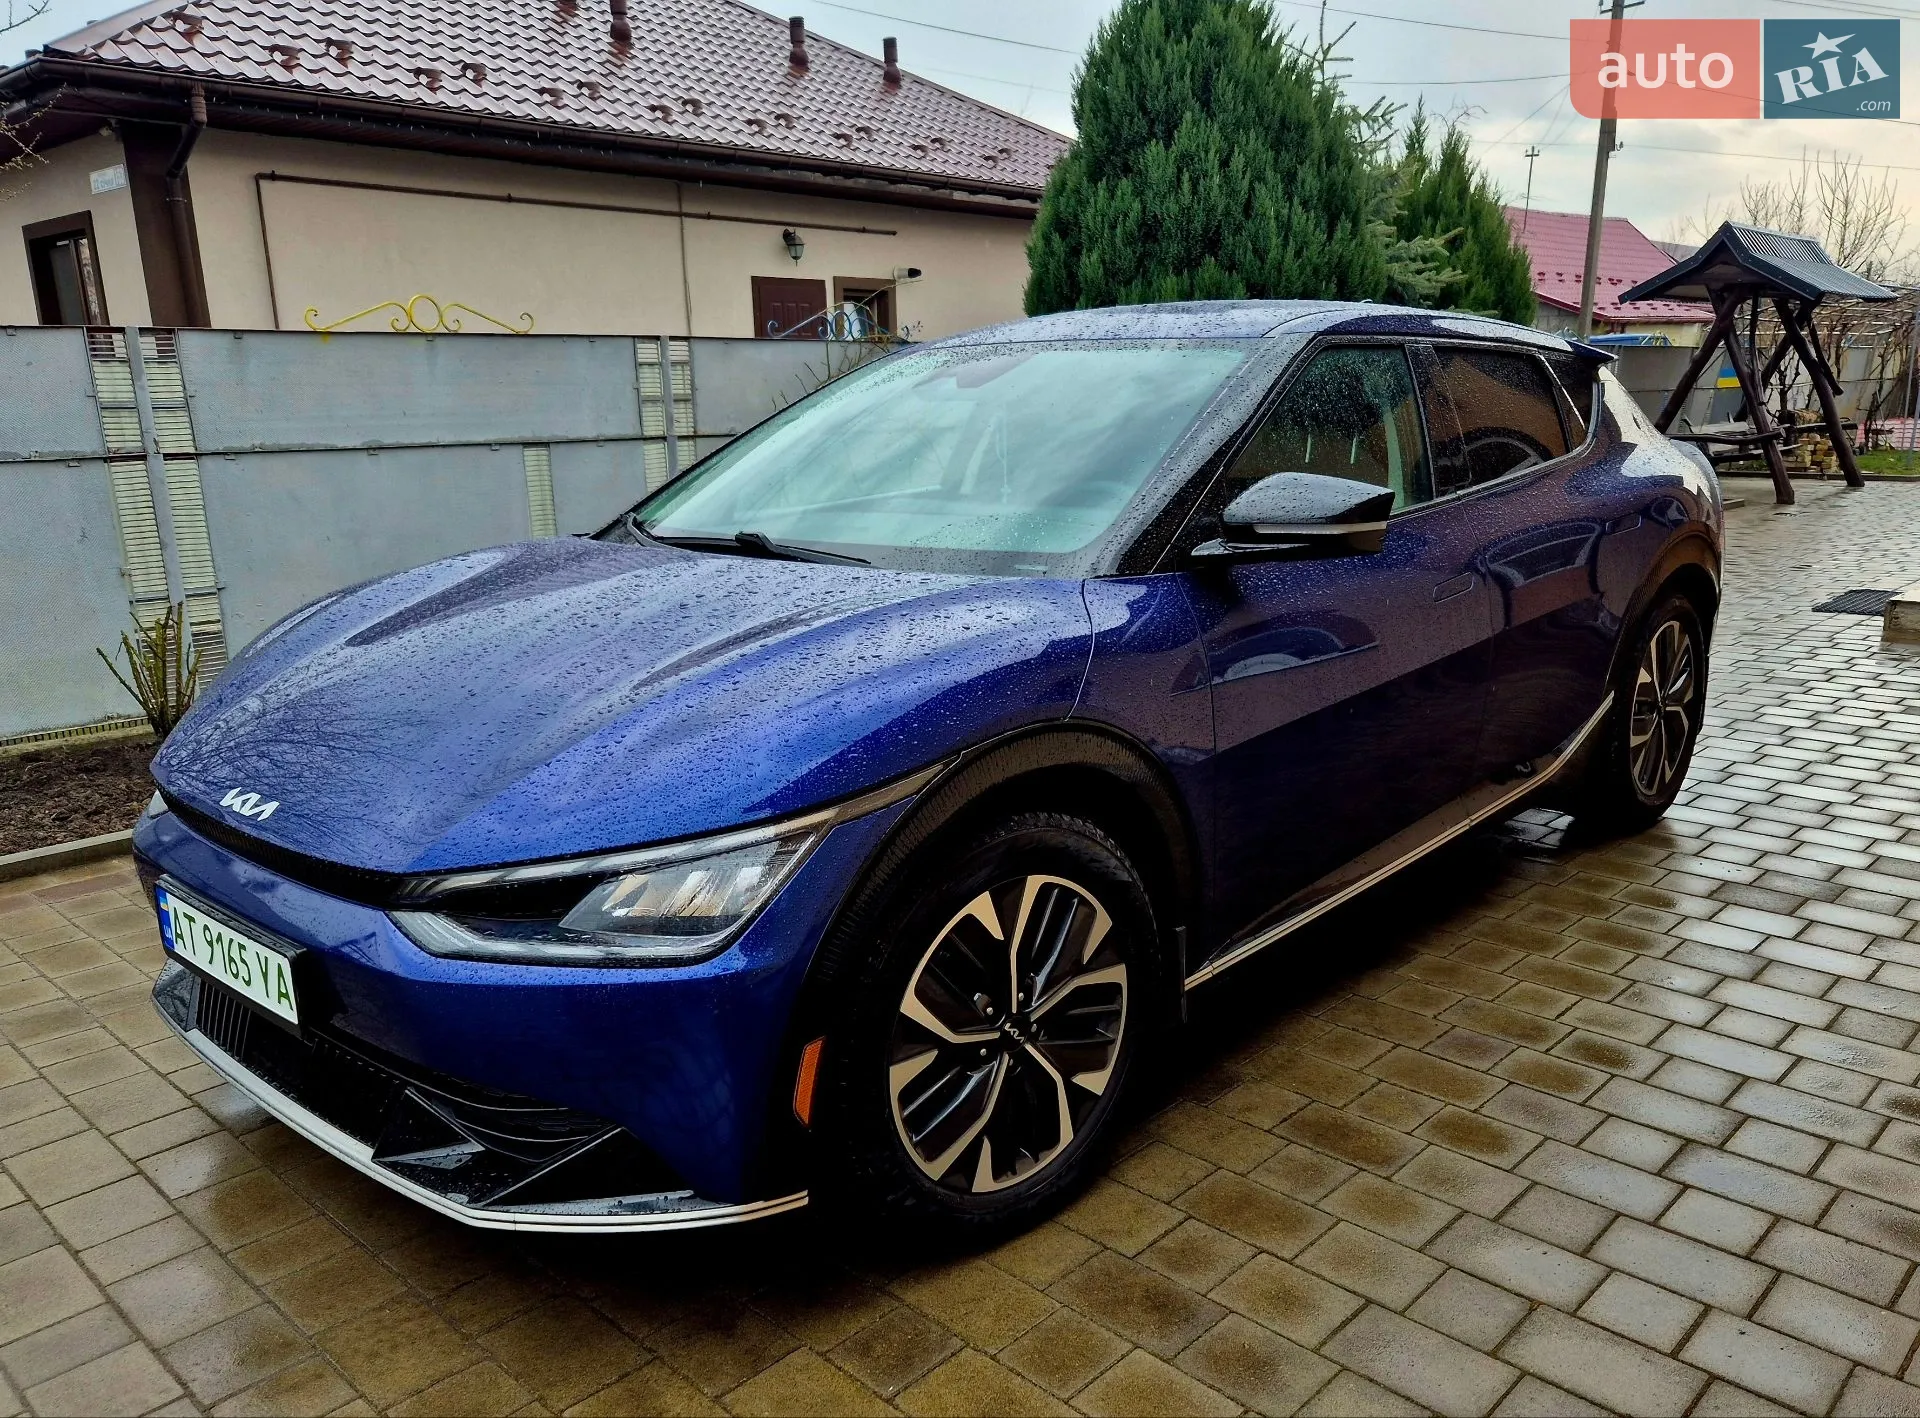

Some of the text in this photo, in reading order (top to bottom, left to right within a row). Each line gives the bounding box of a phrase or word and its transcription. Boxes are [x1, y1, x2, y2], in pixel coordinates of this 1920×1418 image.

[173, 906, 293, 1011] AT 9165 YA
